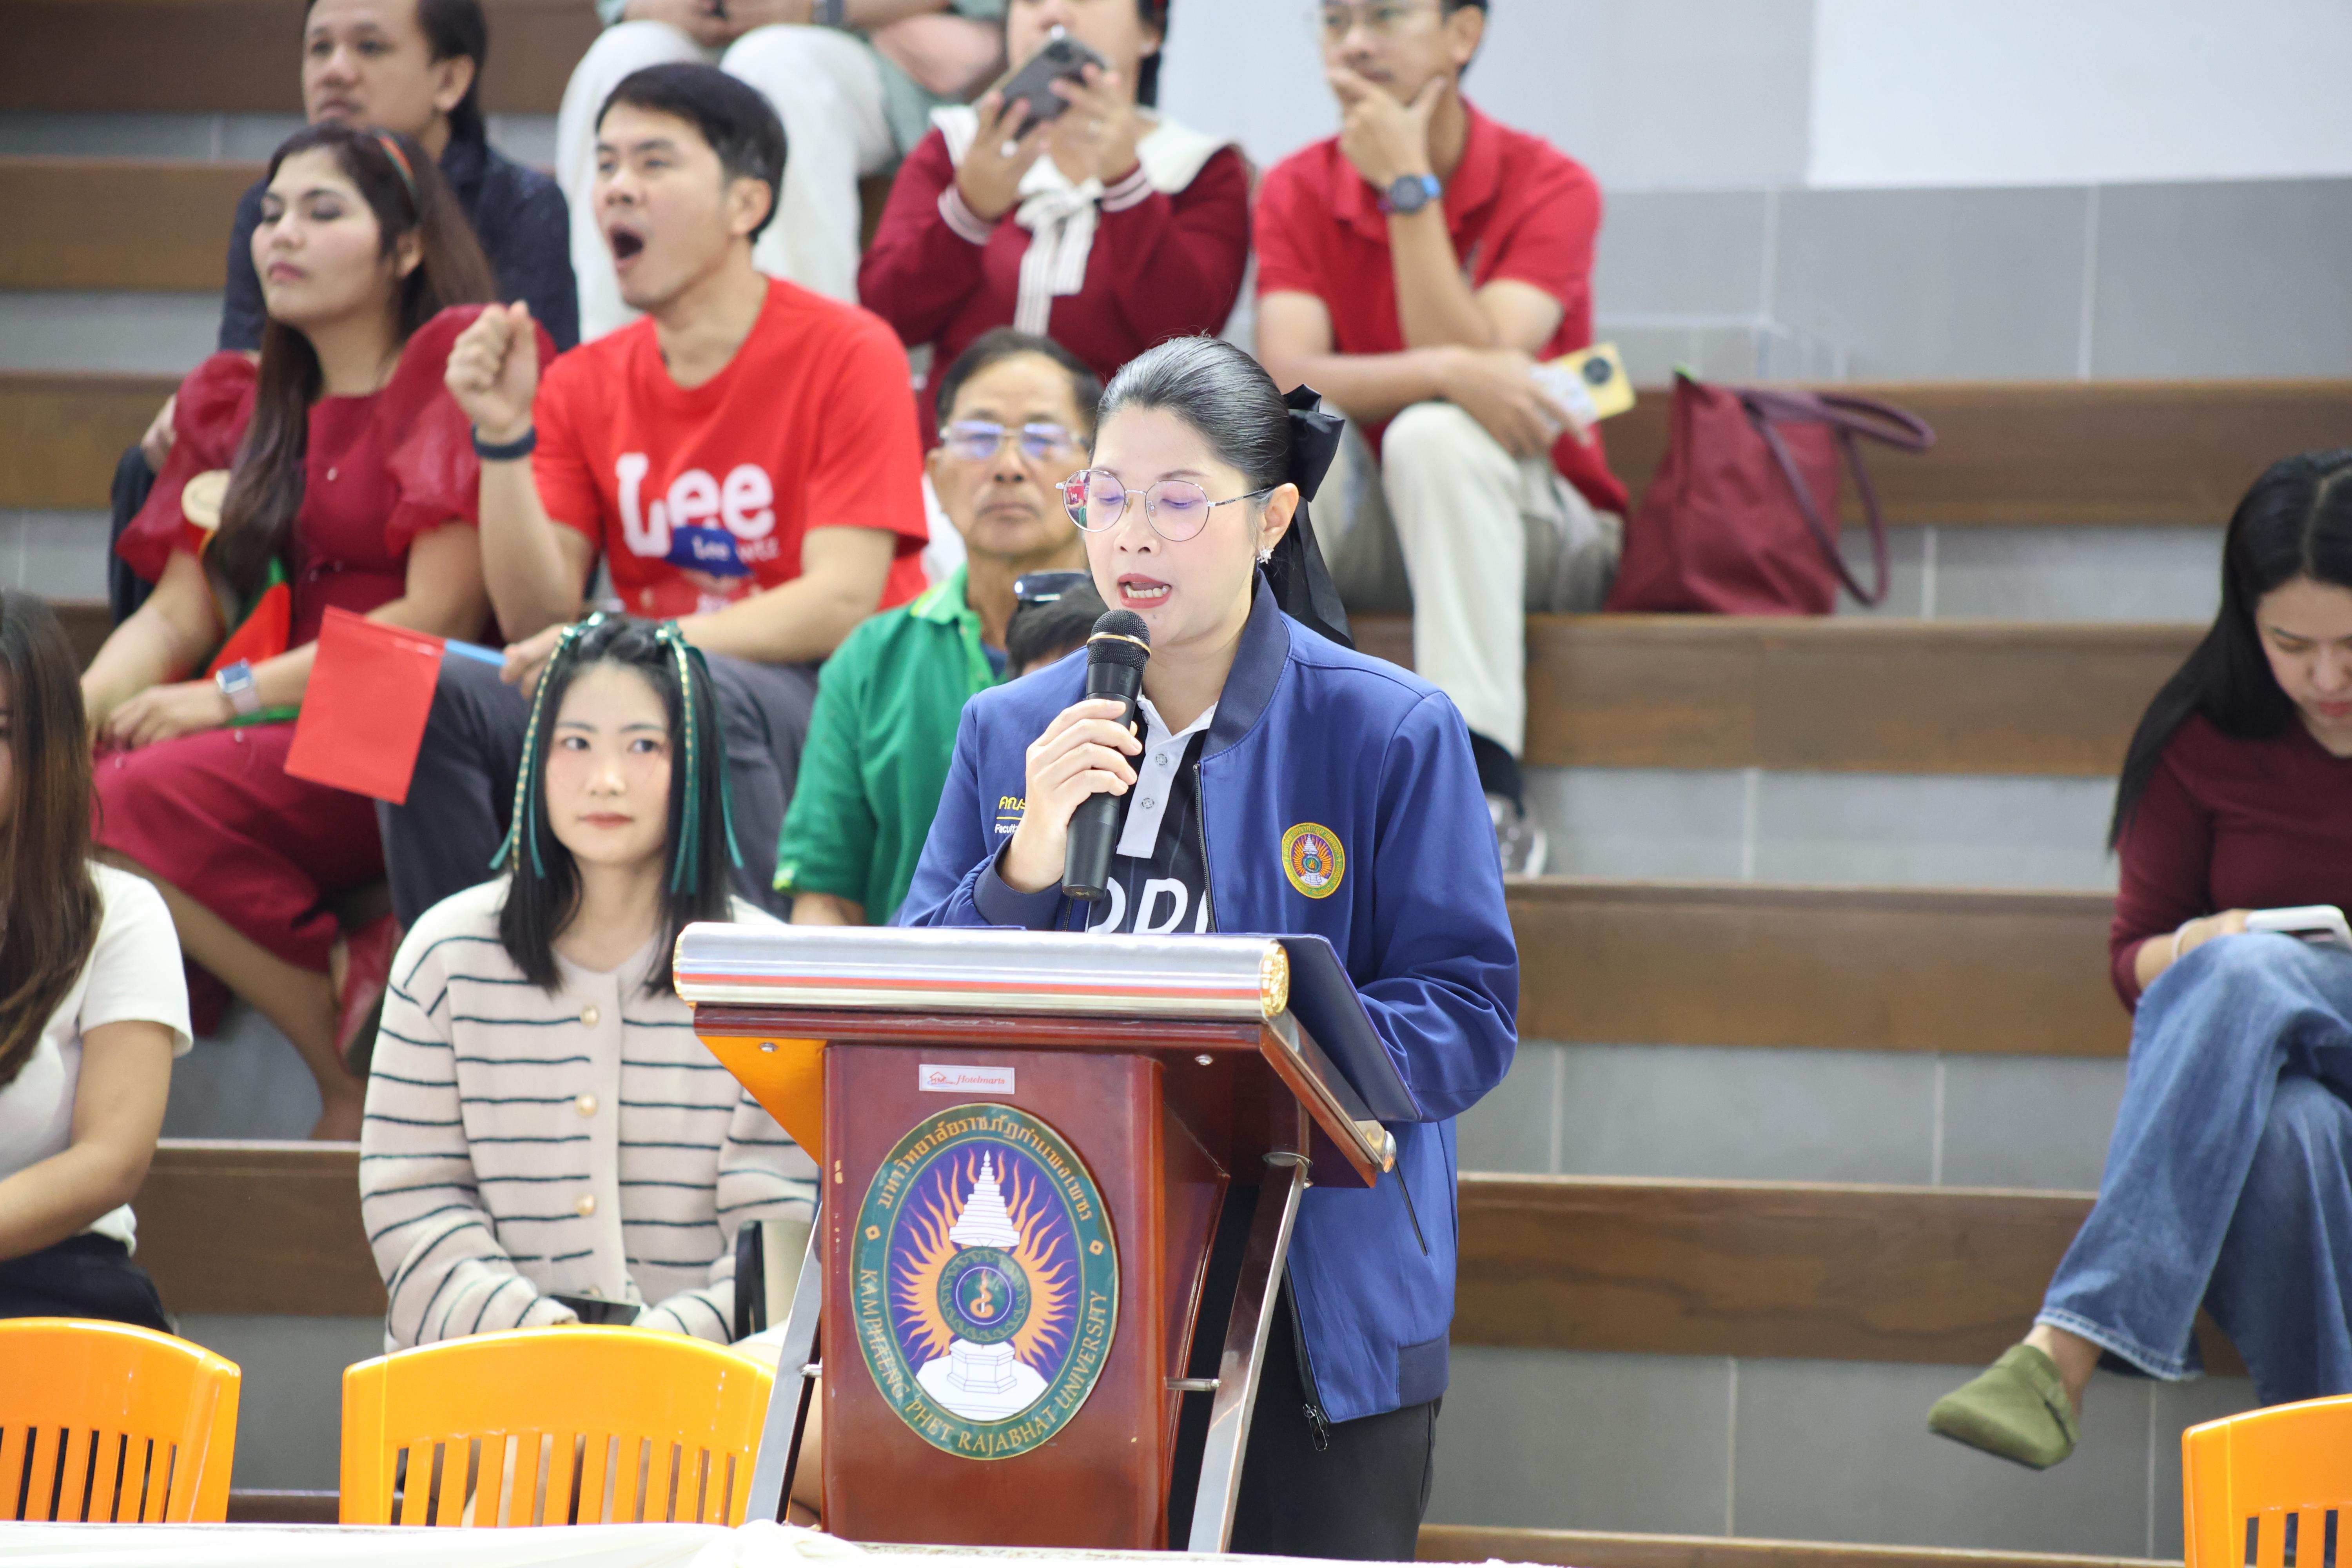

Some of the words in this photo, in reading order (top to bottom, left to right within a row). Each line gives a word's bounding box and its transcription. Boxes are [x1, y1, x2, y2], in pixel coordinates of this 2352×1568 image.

[860, 1269, 910, 1399] KAMPHAENG
[905, 1399, 955, 1441] PHET
[958, 1405, 1057, 1457] RAJABHAT
[1054, 1290, 1107, 1409] UNIVERSITY
